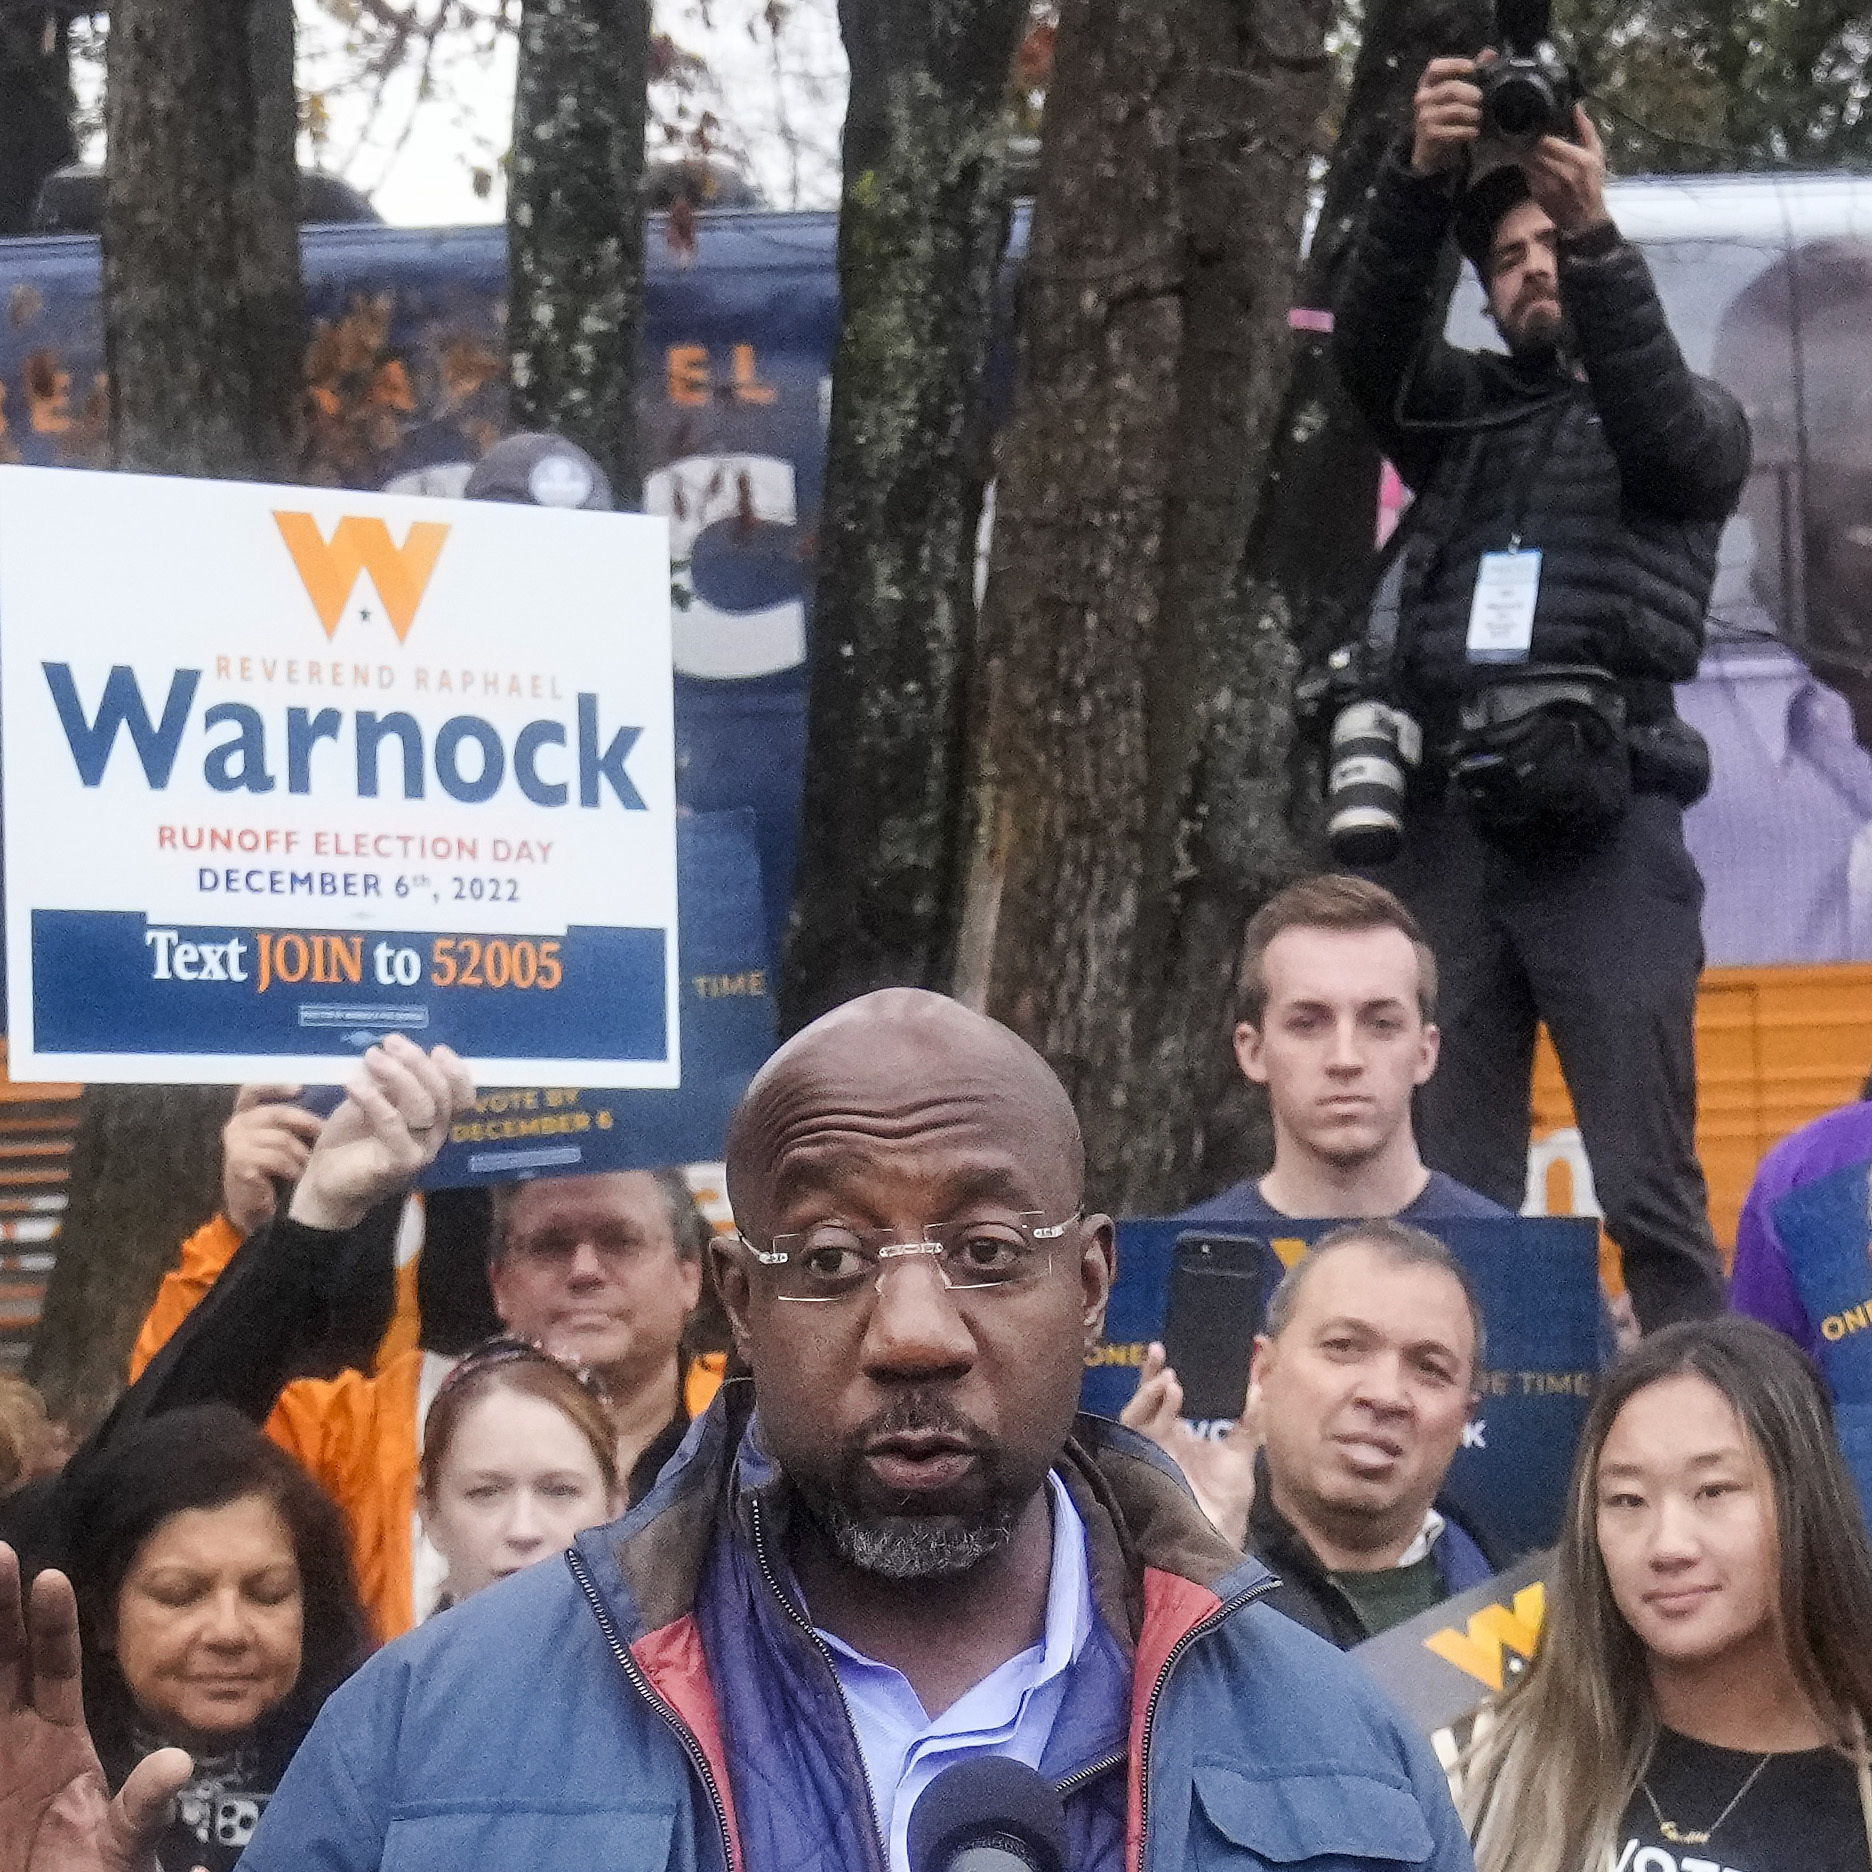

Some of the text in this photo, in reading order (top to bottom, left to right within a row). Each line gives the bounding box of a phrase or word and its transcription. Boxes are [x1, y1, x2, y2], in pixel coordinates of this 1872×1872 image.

[215, 656, 564, 701] REVEREND RAPHAEL
[40, 661, 650, 811] Warnock
[157, 825, 556, 865] RUNOFF ELECTION DAY
[197, 867, 381, 898] DECEMBER
[452, 876, 521, 903] 2022
[145, 929, 563, 993] Text JOIN to 52005
[692, 970, 768, 998] TIME
[450, 1111, 592, 1143] DECEMBER
[1521, 1371, 1591, 1397] TIME
